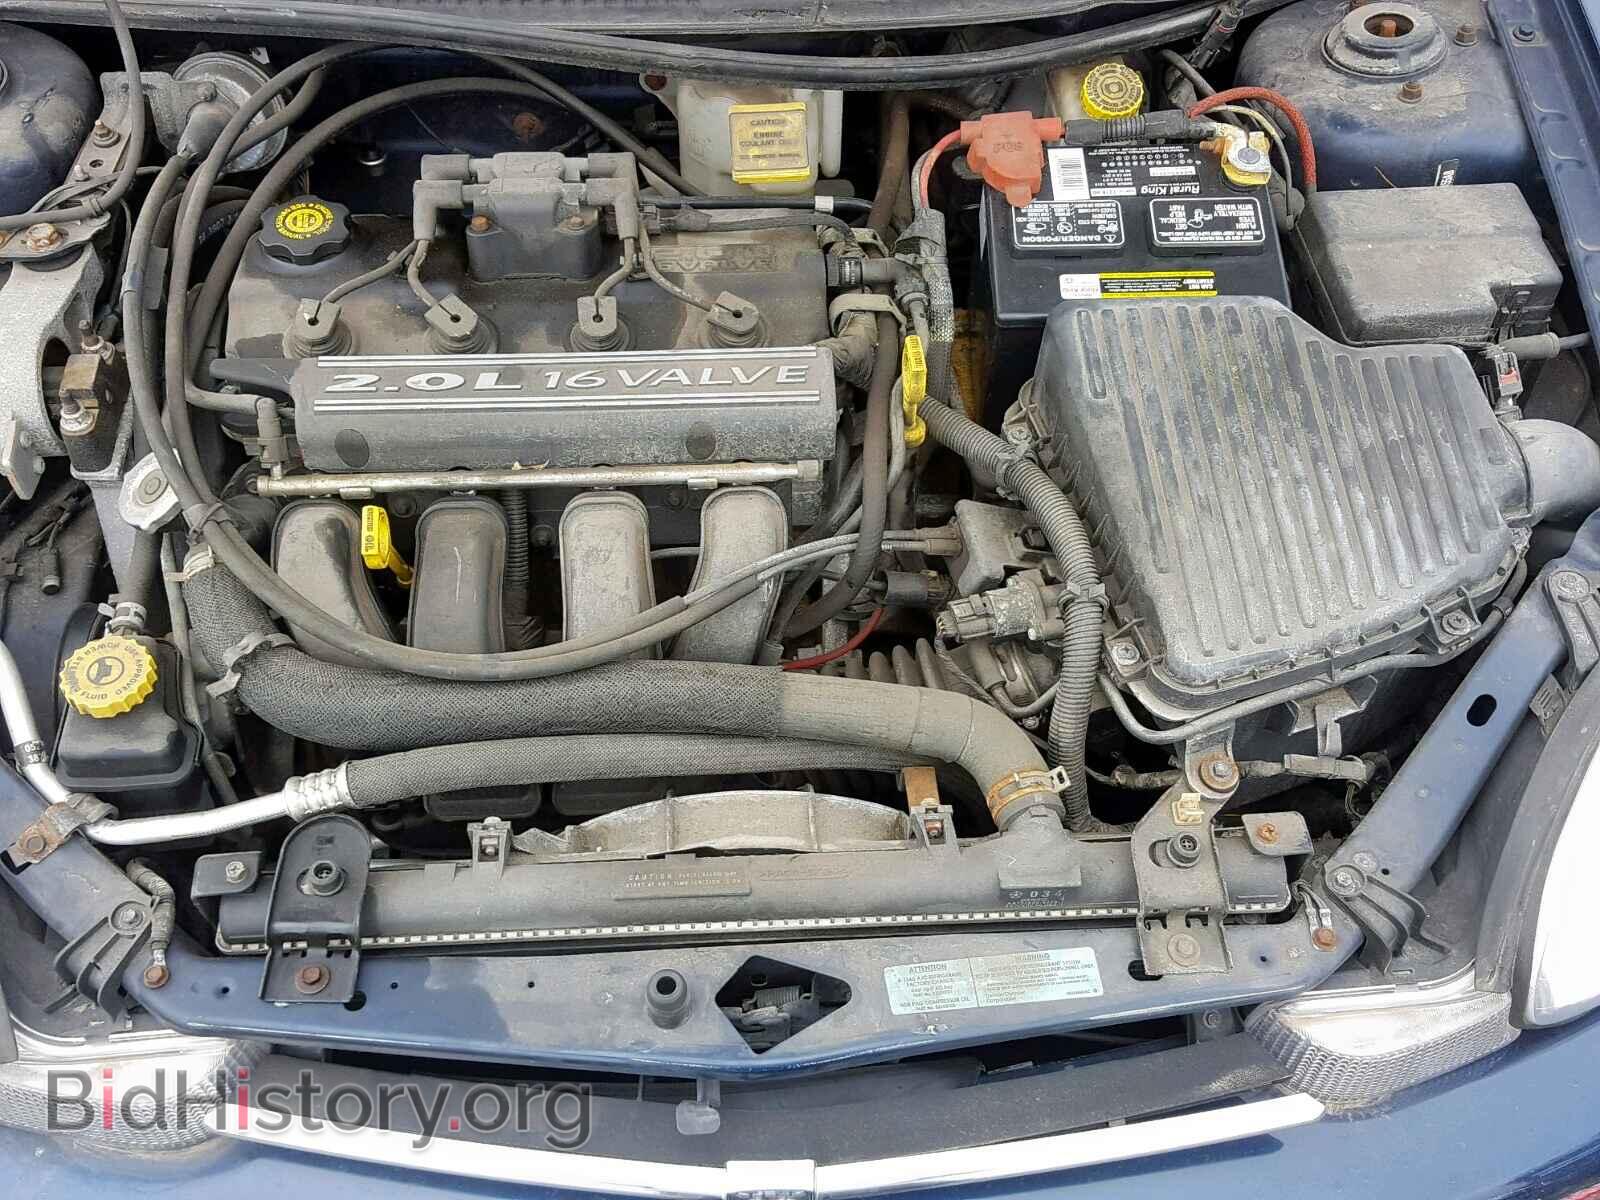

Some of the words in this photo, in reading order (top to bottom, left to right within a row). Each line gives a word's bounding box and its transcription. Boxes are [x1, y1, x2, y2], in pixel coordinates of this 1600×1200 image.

[1140, 185, 1167, 195] King
[1170, 185, 1200, 194] Rural
[1022, 234, 1100, 243] DANGER/POISON
[324, 373, 523, 393] 2.0L
[544, 369, 607, 389] 16
[615, 364, 811, 387] VALVE
[909, 963, 948, 974] ATTENTION
